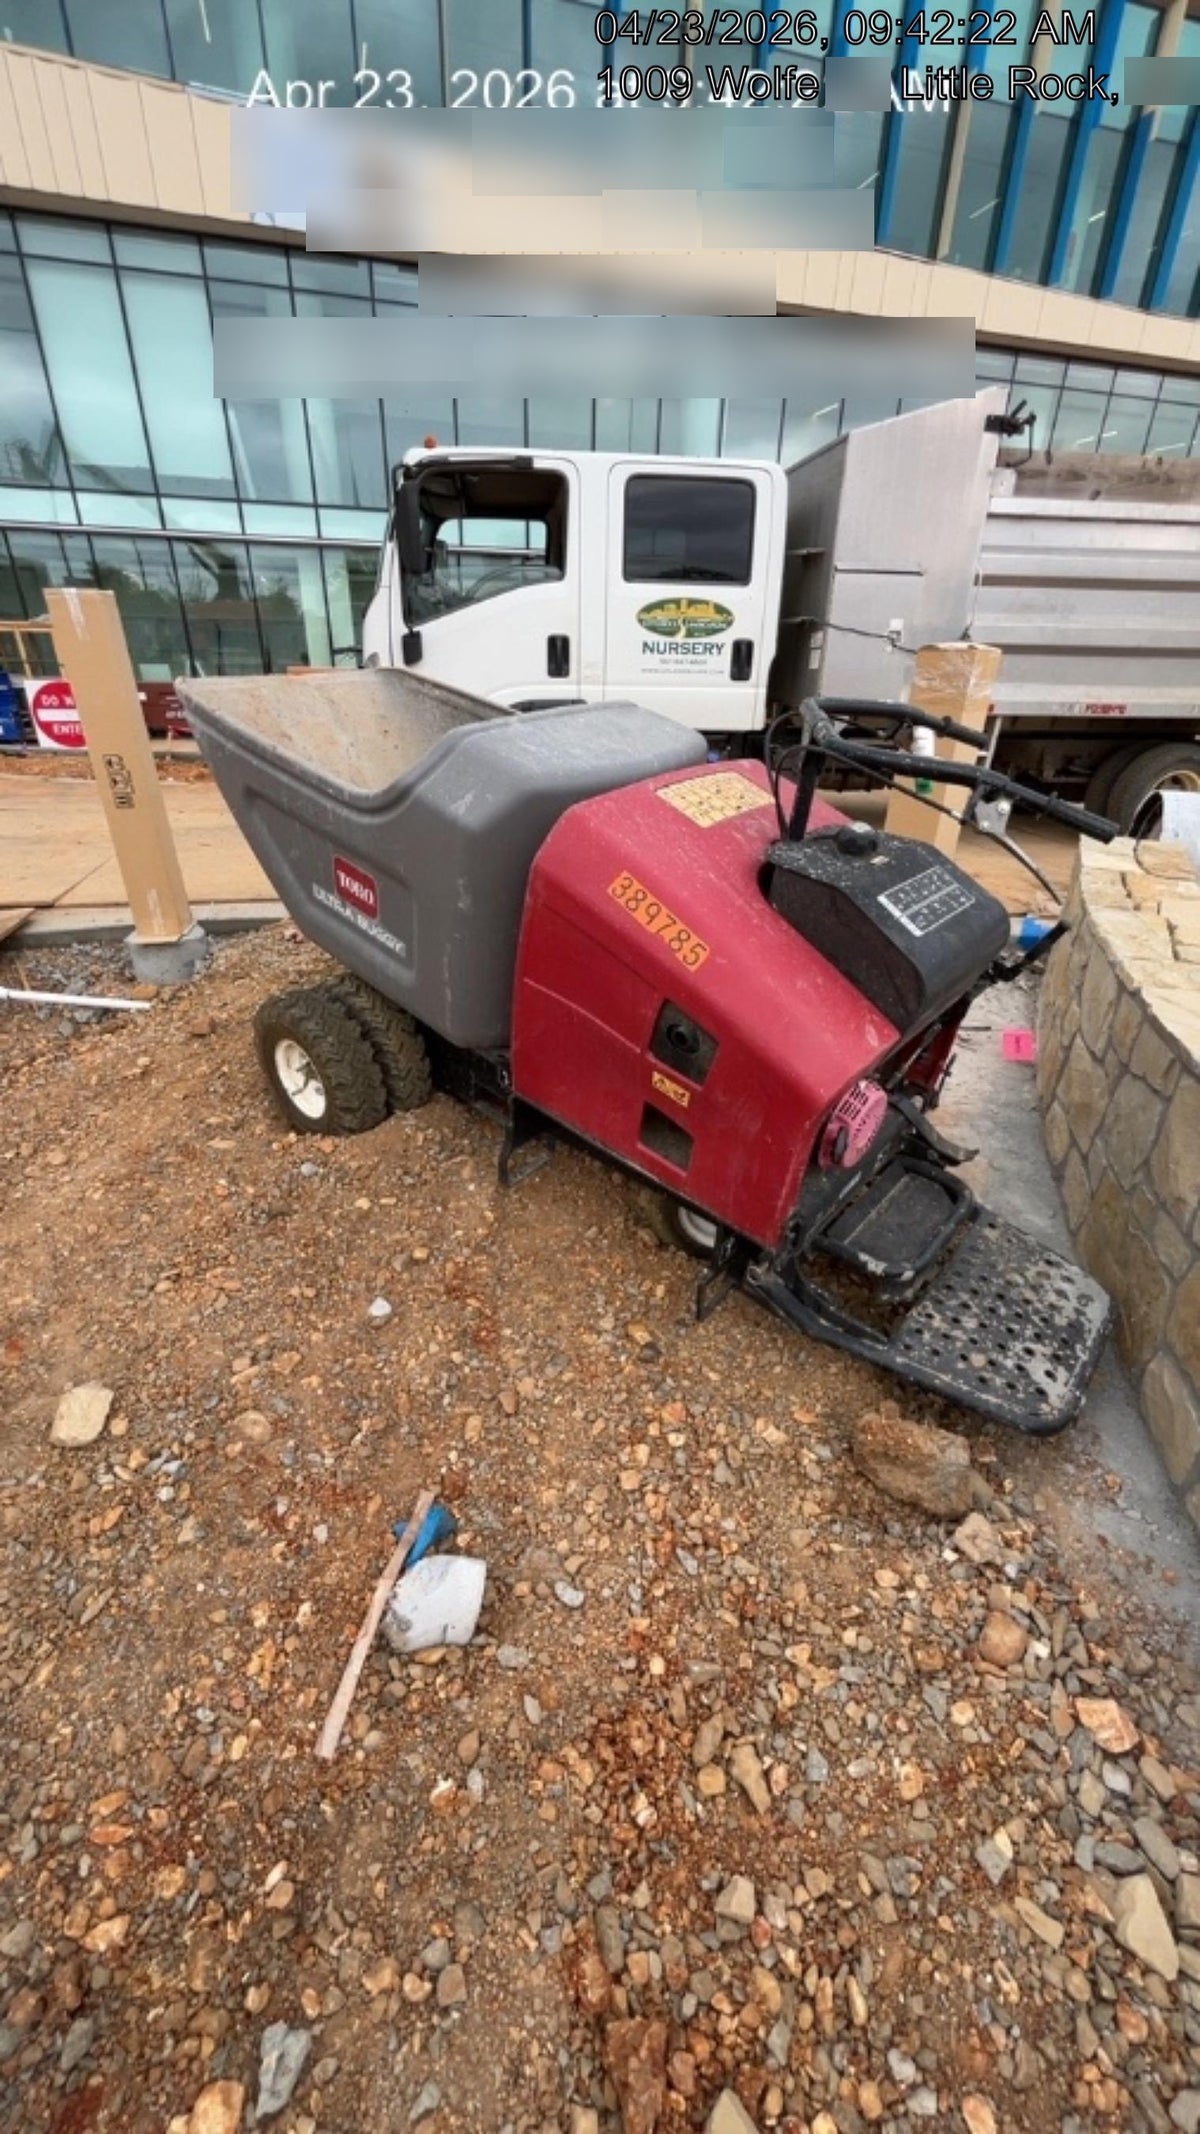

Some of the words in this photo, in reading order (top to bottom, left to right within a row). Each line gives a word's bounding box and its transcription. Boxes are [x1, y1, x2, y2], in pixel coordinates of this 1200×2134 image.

[642, 641, 726, 656] NURSERY
[41, 694, 60, 706] DO
[53, 725, 82, 736] ENTE
[336, 869, 375, 905] TORO
[611, 876, 708, 967] 389785
